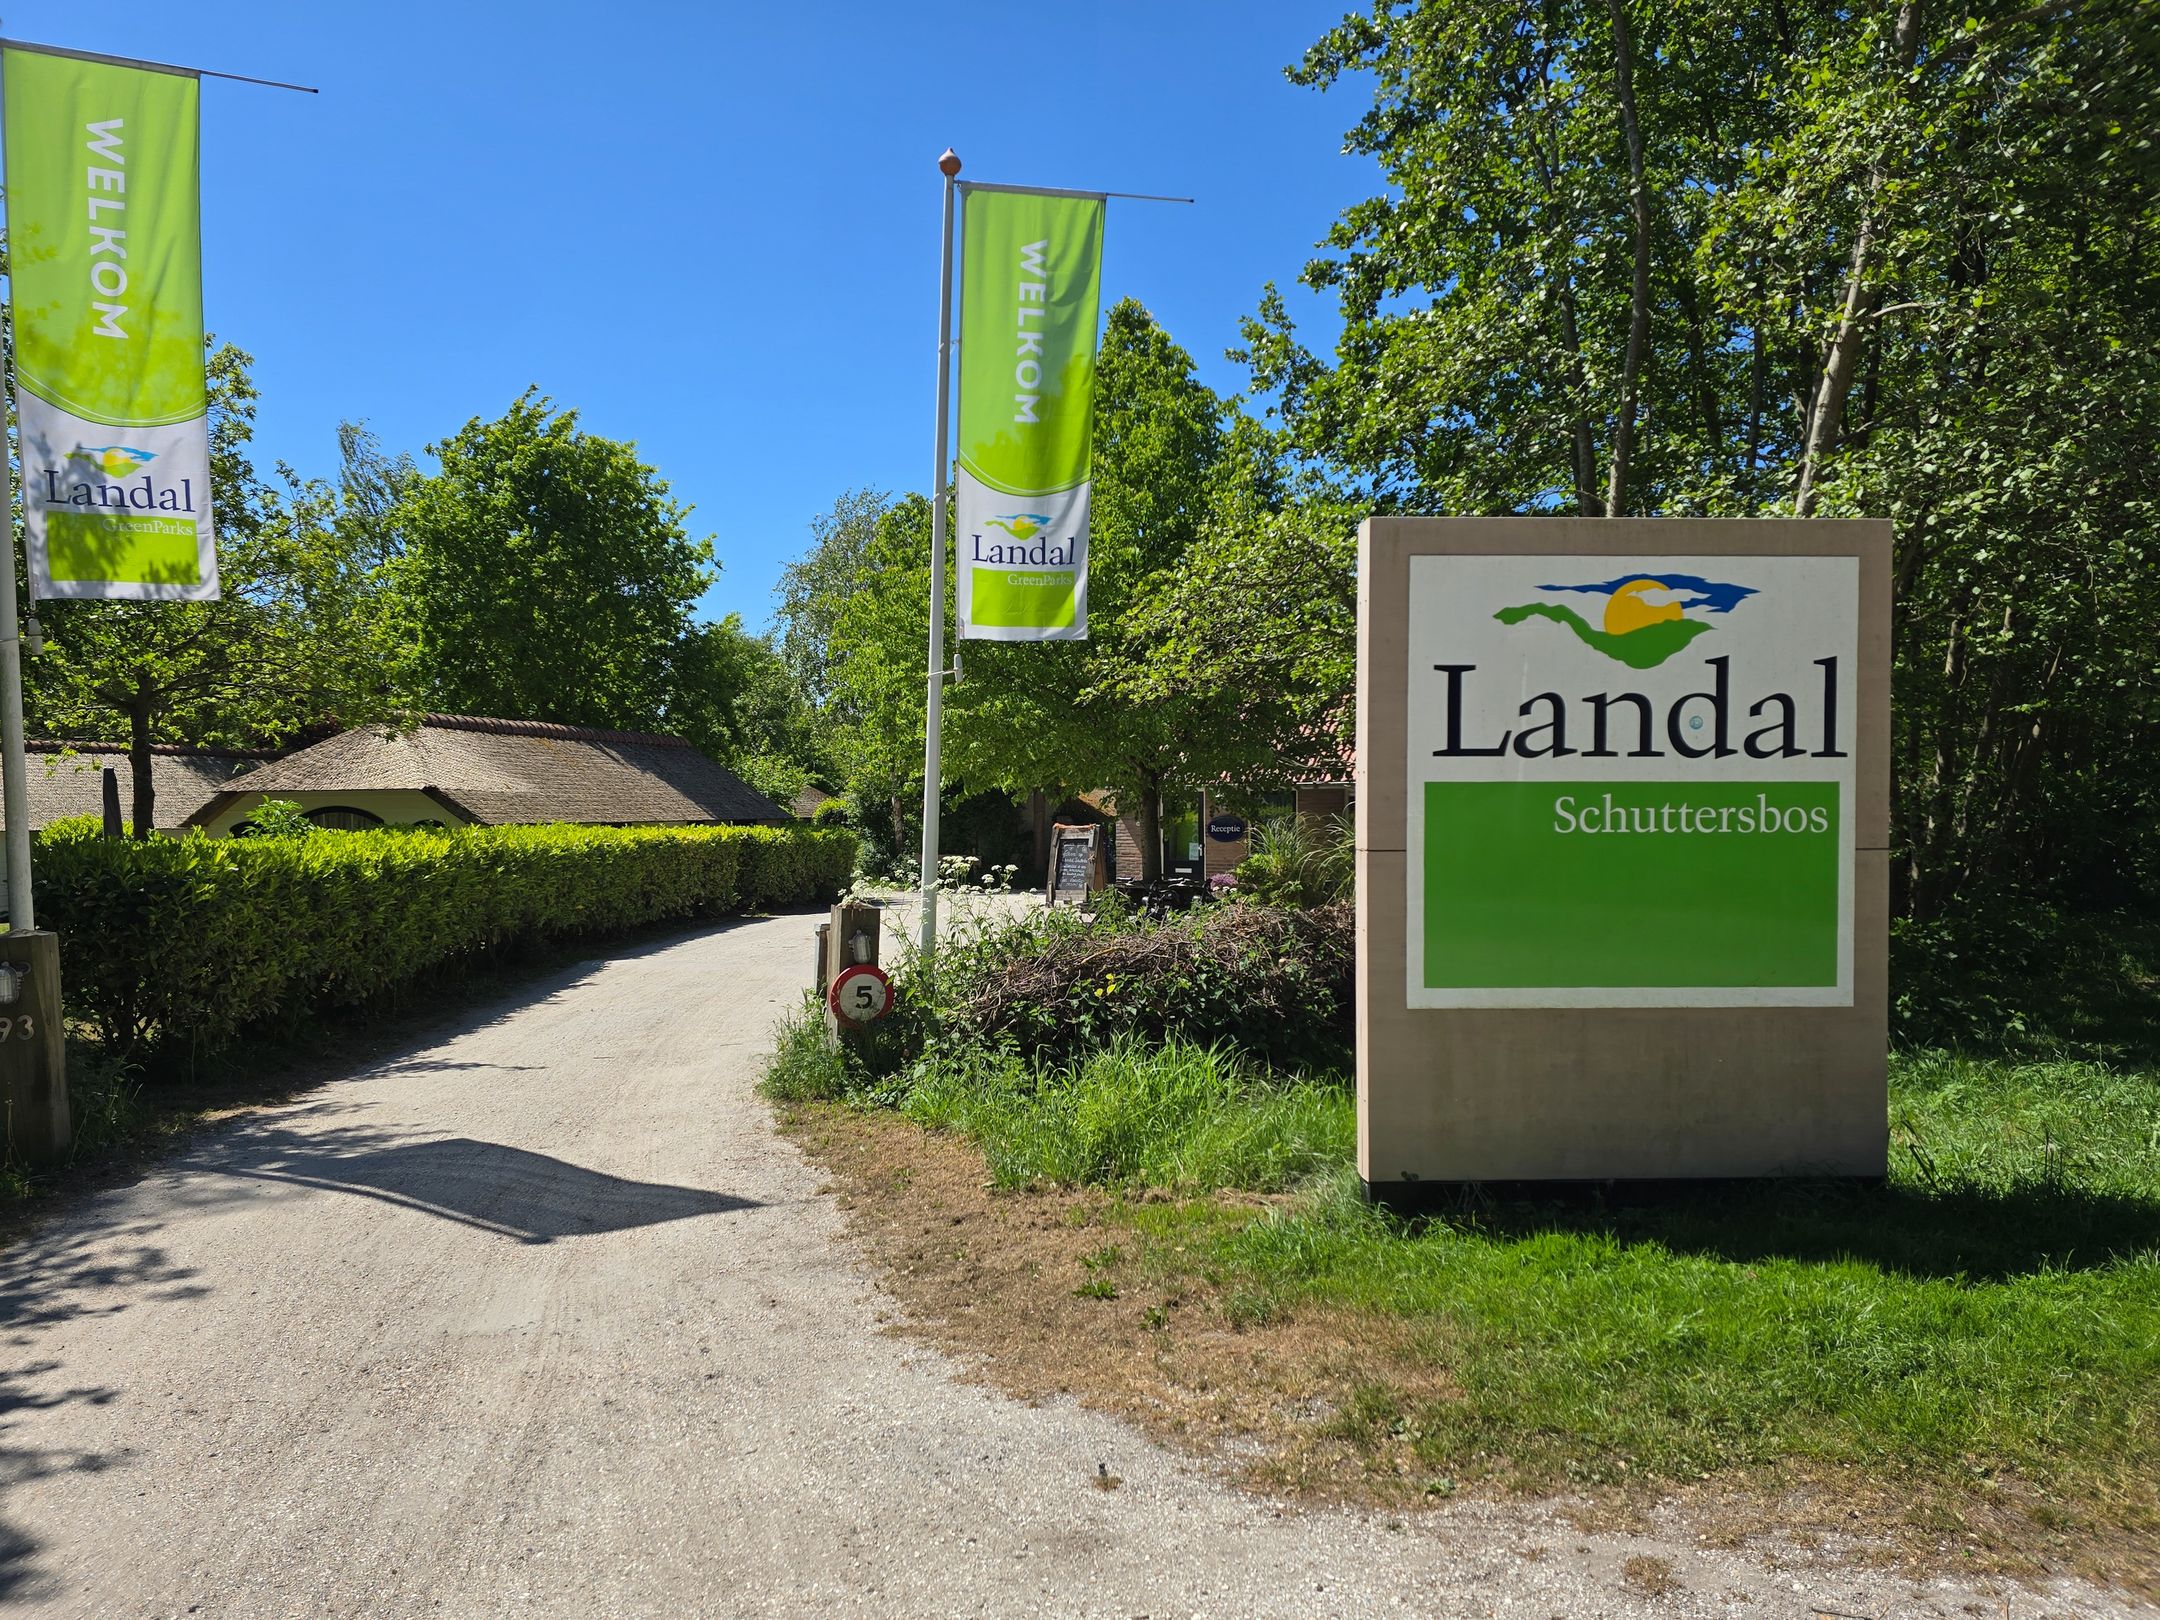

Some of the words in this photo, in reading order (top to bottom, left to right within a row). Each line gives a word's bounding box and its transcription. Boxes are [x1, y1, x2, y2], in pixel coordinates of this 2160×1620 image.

[86, 118, 129, 339] WELKOM
[1014, 239, 1048, 424] WELKOM
[43, 469, 197, 513] Landal
[102, 518, 194, 537] GreenParks
[971, 534, 1076, 566] Landal
[1007, 573, 1073, 587] GreenParks
[1431, 655, 1849, 760] Landal
[1210, 824, 1241, 834] Receptie
[1553, 793, 1829, 835] Schuttersbos
[855, 985, 873, 1009] 5
